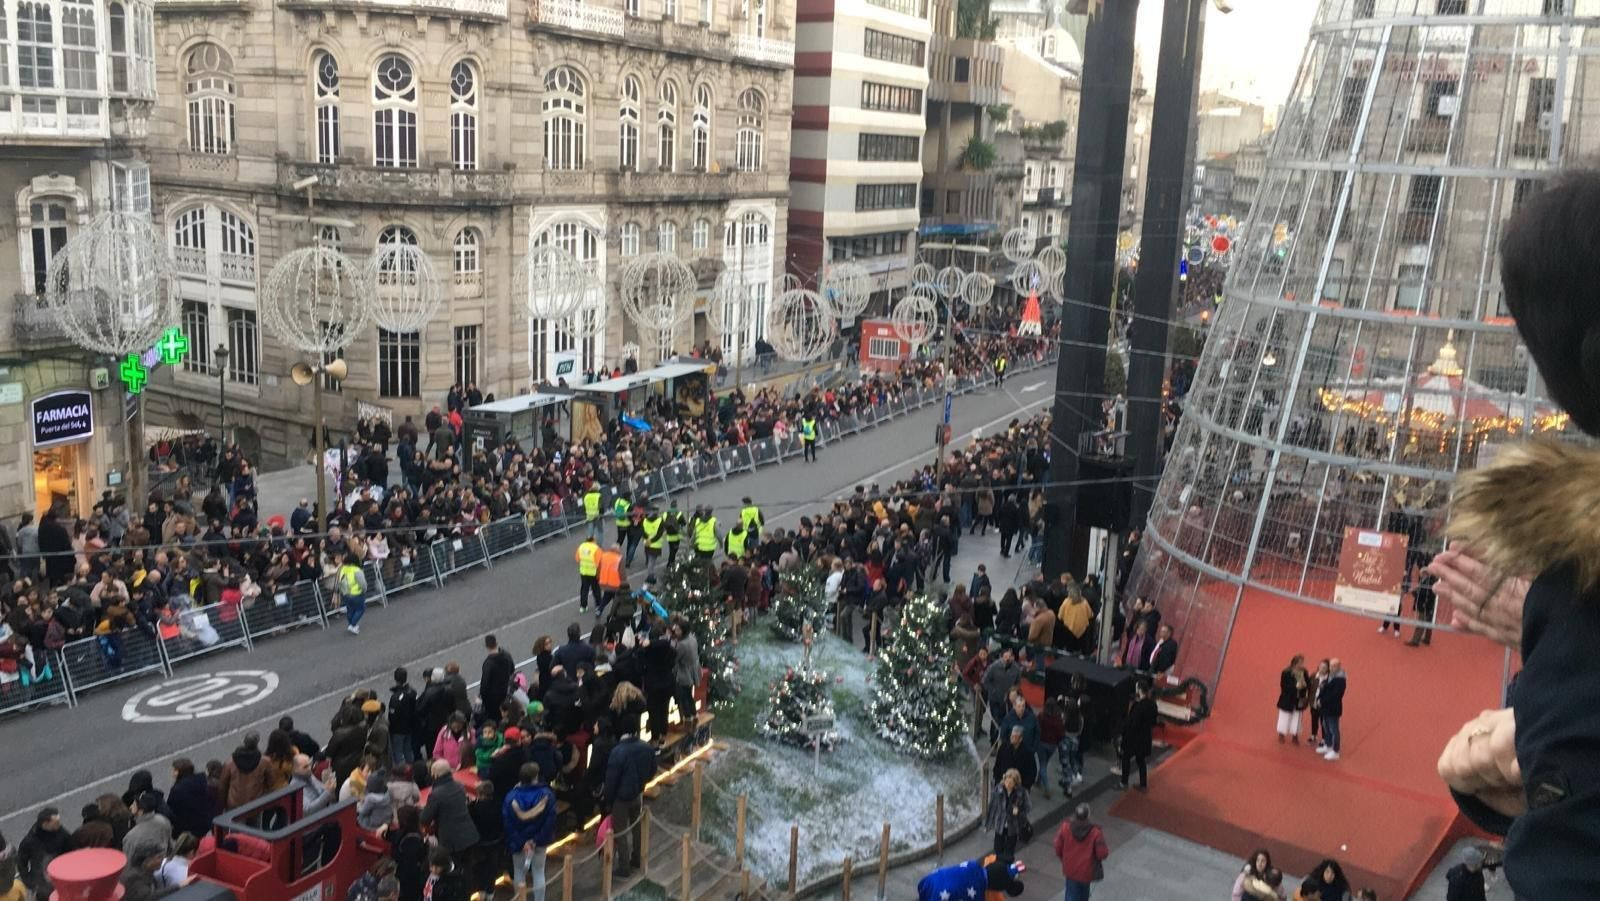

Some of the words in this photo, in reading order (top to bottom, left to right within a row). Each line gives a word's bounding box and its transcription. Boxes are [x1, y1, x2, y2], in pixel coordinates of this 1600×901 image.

[36, 403, 89, 424] FARMACIA
[41, 425, 60, 435] Puerta
[61, 421, 70, 431] del
